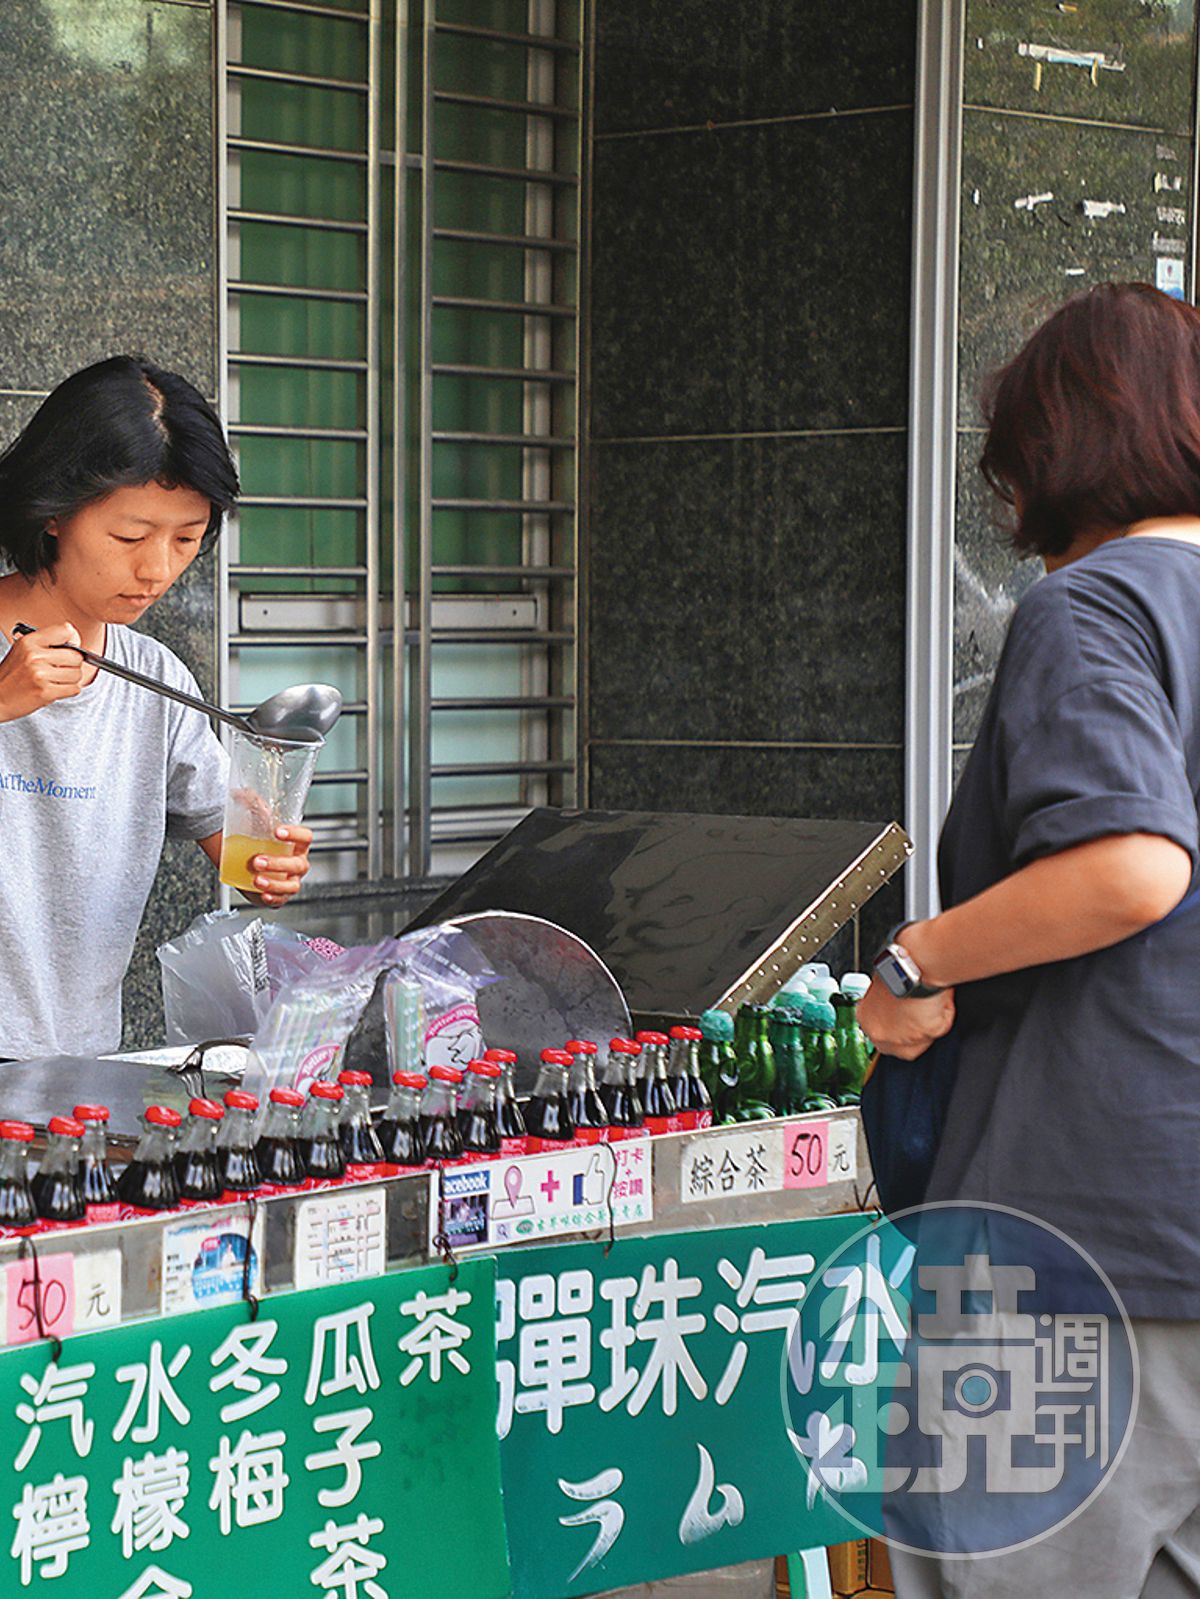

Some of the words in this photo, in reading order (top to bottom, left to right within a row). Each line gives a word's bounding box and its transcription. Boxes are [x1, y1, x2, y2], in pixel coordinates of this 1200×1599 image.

[443, 1171, 488, 1195] acebook
[690, 1143, 768, 1196] 綜合茶
[791, 1133, 822, 1176] 50
[833, 1144, 851, 1172] 元
[17, 1279, 67, 1331] 50
[86, 1284, 112, 1319] 元
[495, 1234, 917, 1440] 彈珠汽水
